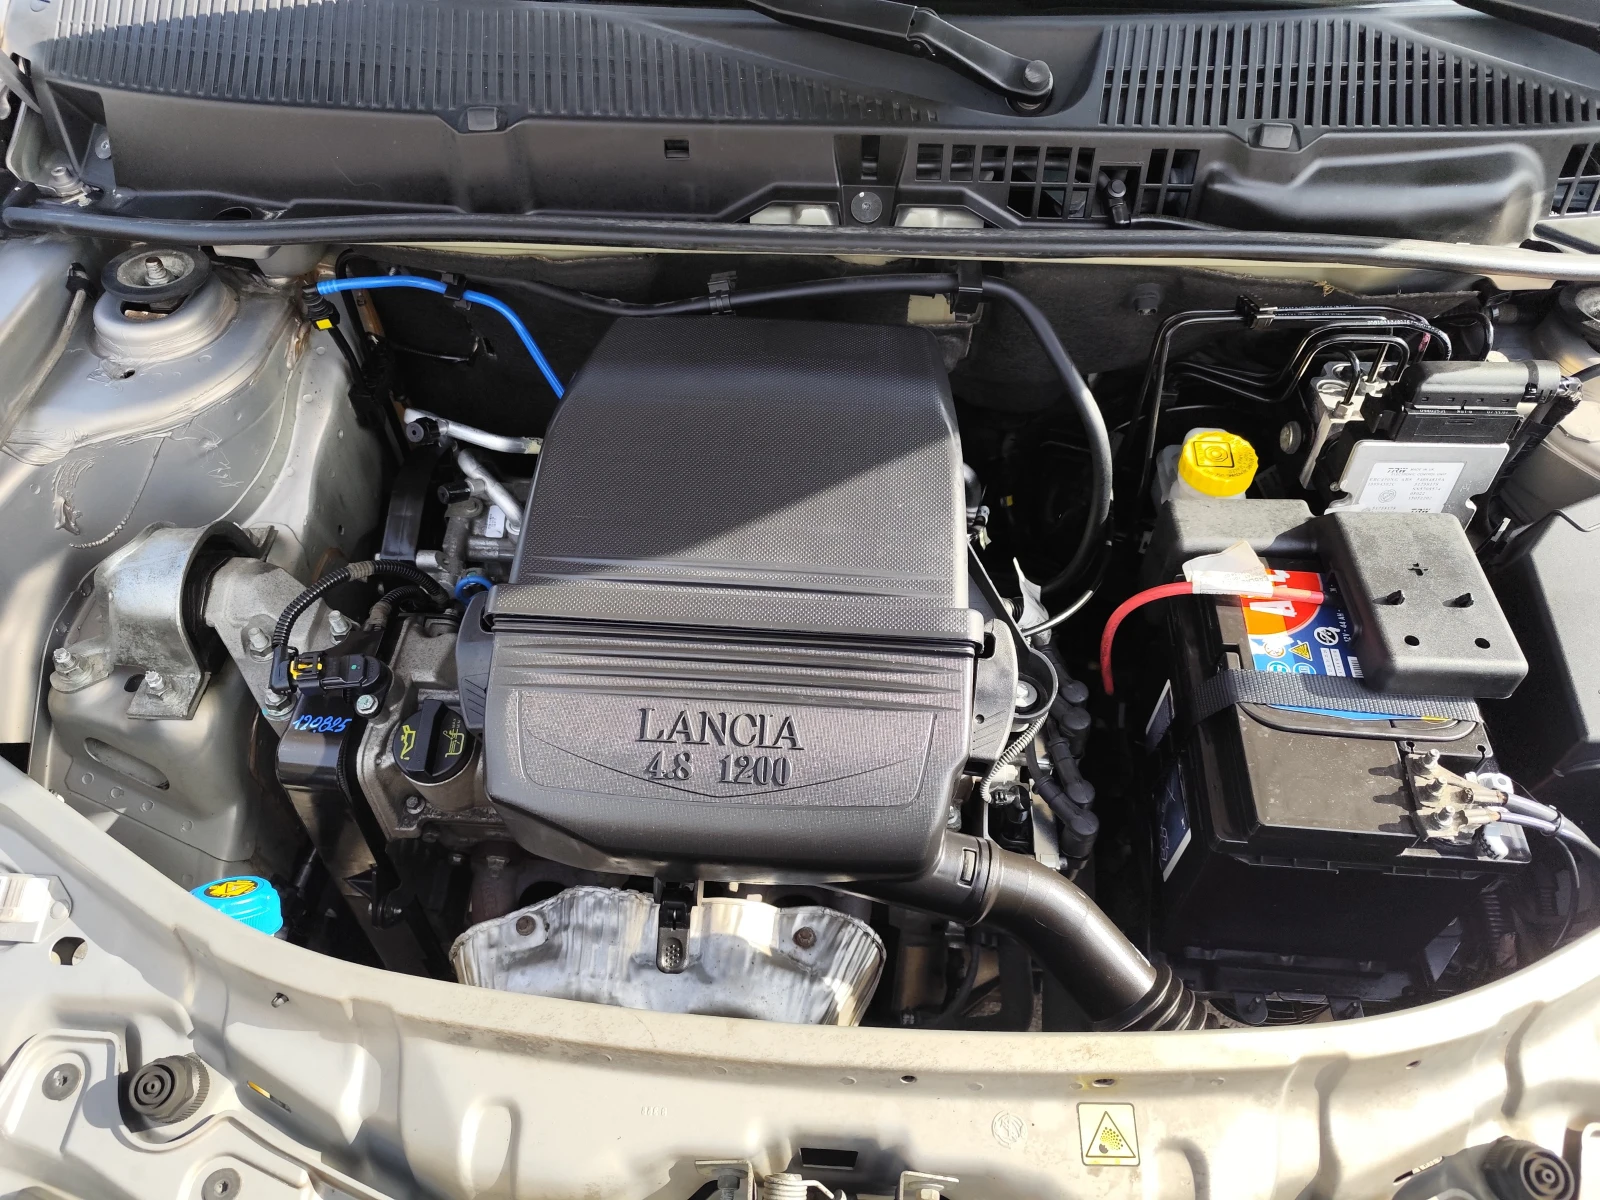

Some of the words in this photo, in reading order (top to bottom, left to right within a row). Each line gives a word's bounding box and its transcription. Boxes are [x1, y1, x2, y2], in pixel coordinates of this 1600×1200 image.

[635, 707, 805, 751] LANCIA
[645, 750, 694, 781] 4.8
[718, 753, 793, 786] 1200
